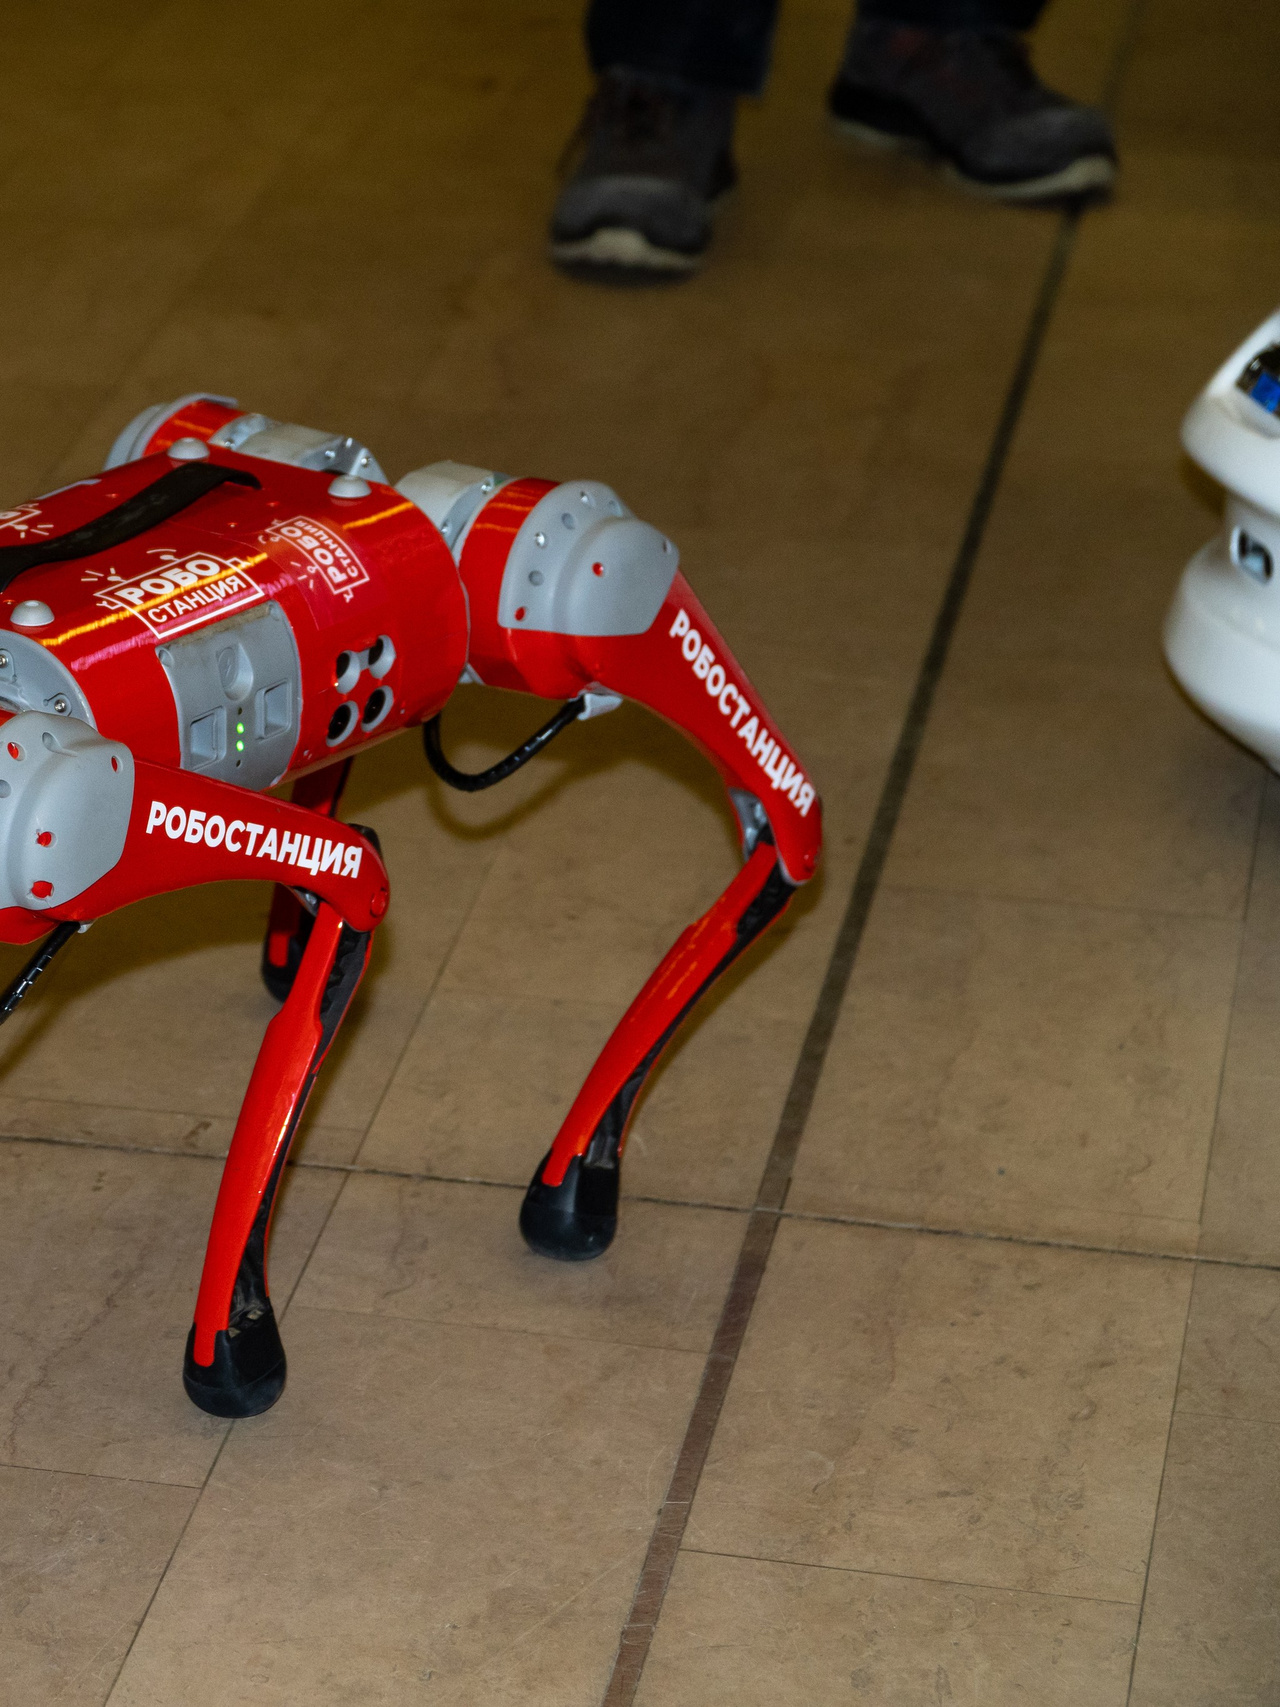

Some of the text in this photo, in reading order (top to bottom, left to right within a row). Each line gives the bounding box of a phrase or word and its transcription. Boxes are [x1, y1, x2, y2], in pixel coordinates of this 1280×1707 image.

[280, 526, 348, 584] РОБО
[294, 520, 359, 578] СТАНЦИЯ
[114, 559, 220, 606] РОБО
[147, 575, 247, 623] СТАНЦИЯ
[669, 608, 816, 818] РОБОСТАНЦИЯ
[146, 800, 363, 879] РОБОСТАНЦИЯ
